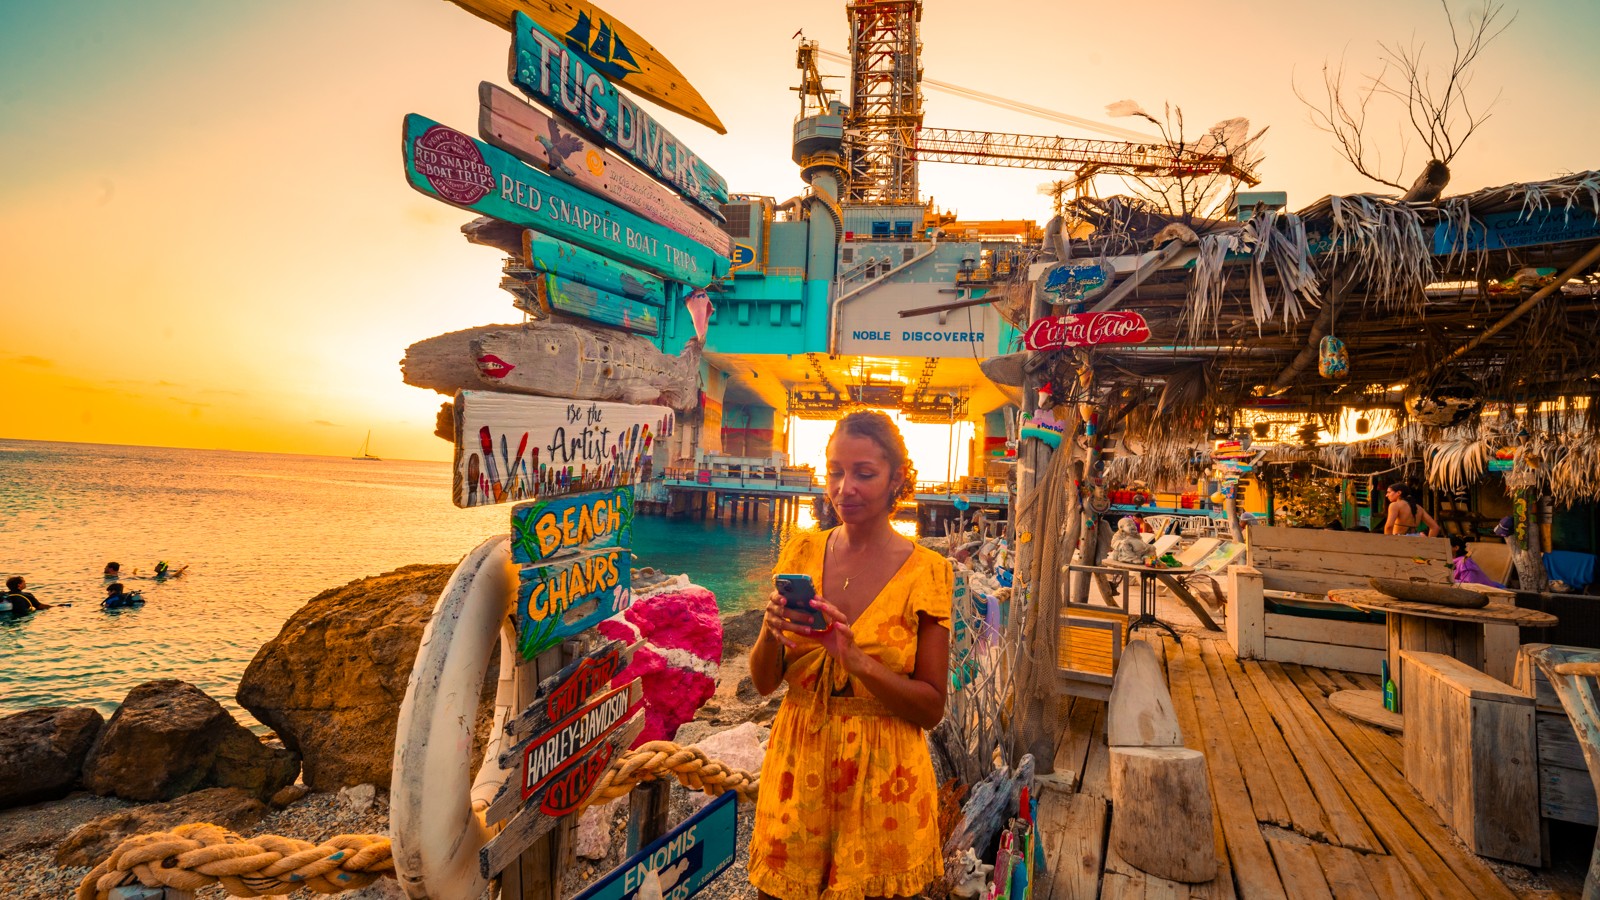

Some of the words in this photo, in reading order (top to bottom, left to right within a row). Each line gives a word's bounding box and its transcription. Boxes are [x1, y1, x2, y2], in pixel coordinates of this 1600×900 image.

[531, 27, 609, 131] TUG
[616, 92, 702, 199] DIVERS
[415, 146, 437, 164] RED
[440, 154, 492, 176] SNAPPER
[426, 163, 453, 179] BOAT
[455, 169, 495, 188] TRIPS
[500, 173, 543, 213] RED
[549, 197, 621, 243] SNAPPER
[626, 227, 659, 257] BOAT
[664, 243, 697, 272] TRIPS
[852, 330, 891, 341] NOBLE
[902, 330, 985, 343] DISCOVERER
[567, 403, 582, 424] Be
[587, 402, 603, 426] the
[547, 426, 612, 465] Artist
[534, 495, 621, 558] BEACH
[528, 552, 620, 621] CHAIRS
[611, 584, 629, 612] 10
[556, 660, 613, 721] MOTOR
[526, 687, 630, 788] HARLEY-DAVIDSON
[549, 748, 605, 809] CYCLES
[623, 824, 698, 895] ENOMIS
